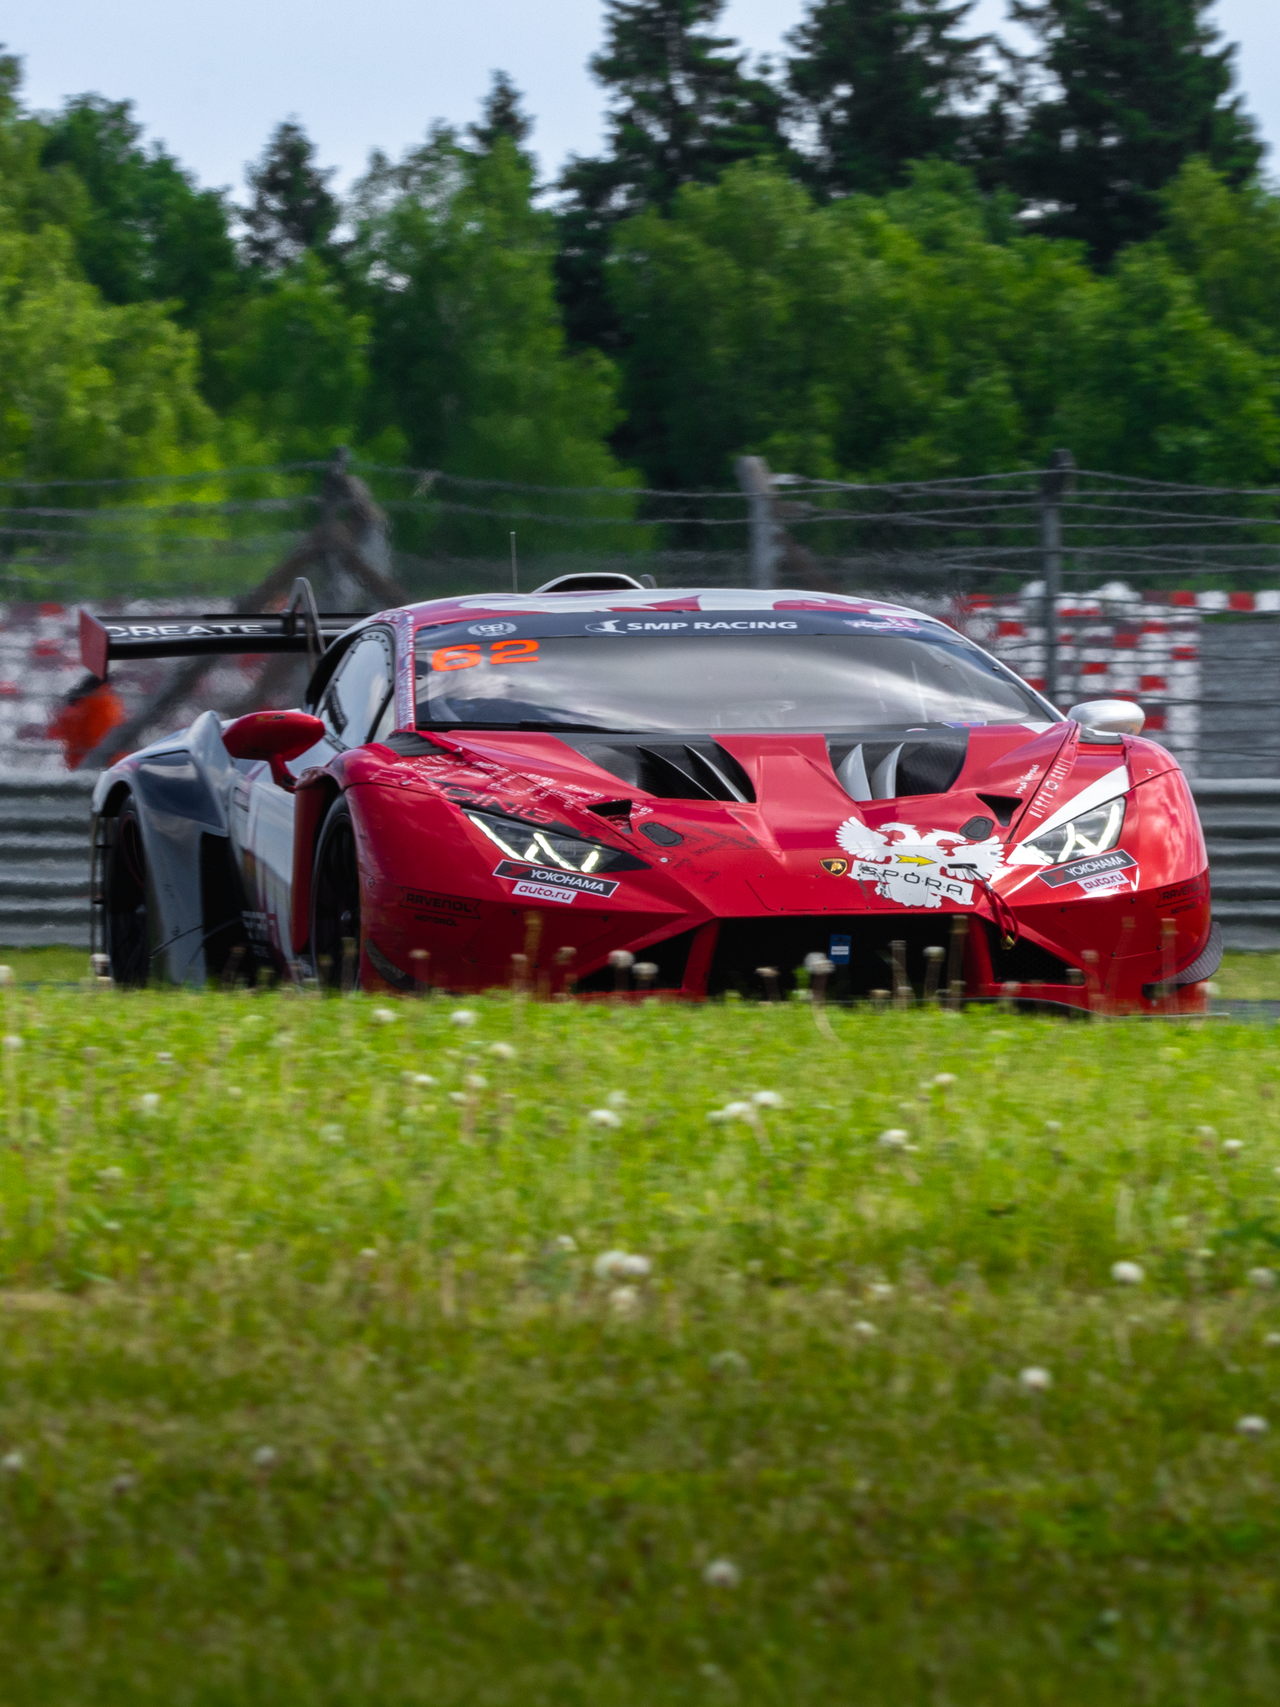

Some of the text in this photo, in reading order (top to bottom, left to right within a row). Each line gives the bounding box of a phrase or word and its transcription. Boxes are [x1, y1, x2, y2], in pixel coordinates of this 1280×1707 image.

[627, 621, 798, 631] SMP RACING
[431, 639, 540, 672] 62
[1065, 855, 1127, 877] YOKOHAMA
[531, 869, 604, 892] YOKOHAMA
[1083, 873, 1124, 889] auto.ru
[406, 892, 472, 913] RAVENOL
[518, 884, 571, 900] auto.ru
